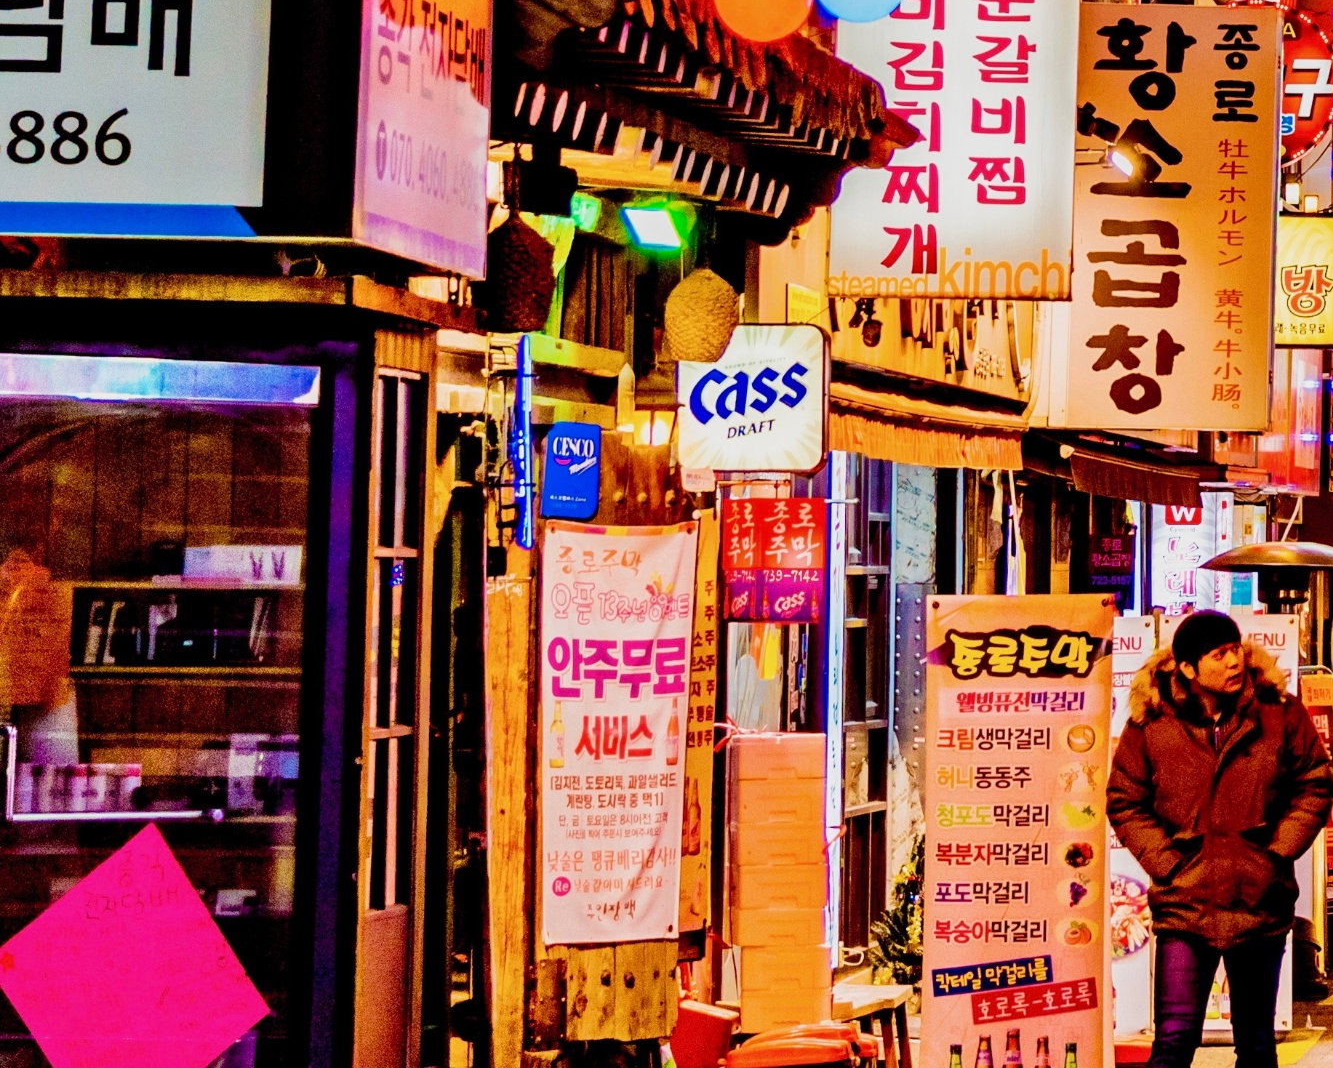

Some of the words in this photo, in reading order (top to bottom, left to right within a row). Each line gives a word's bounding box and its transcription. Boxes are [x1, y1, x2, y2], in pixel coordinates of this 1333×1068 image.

[1087, 17, 1197, 414] 황소곱창
[1212, 23, 1260, 123] 종로
[829, 271, 928, 299] steamed
[938, 246, 1074, 300] kimchi
[689, 362, 809, 425] Cass
[727, 419, 775, 439] DRAFT
[553, 436, 595, 458] CESCO
[765, 502, 817, 532] 종로
[765, 532, 820, 567] 주막
[551, 582, 595, 625] 오픈
[547, 636, 687, 700] 안주무료
[956, 691, 1085, 715] 웰빙퓨전막걸리
[575, 714, 654, 761] 서비스
[936, 727, 1052, 751] 크림생막걸리
[936, 765, 1032, 789] 허니동동주
[935, 804, 1050, 829] 청포도막걸리
[934, 843, 1049, 868] 복분자막걸리
[934, 881, 1029, 906] 포도막걸리
[934, 919, 1048, 944] 복숭아막걸리
[984, 954, 1048, 982] 막걸리를
